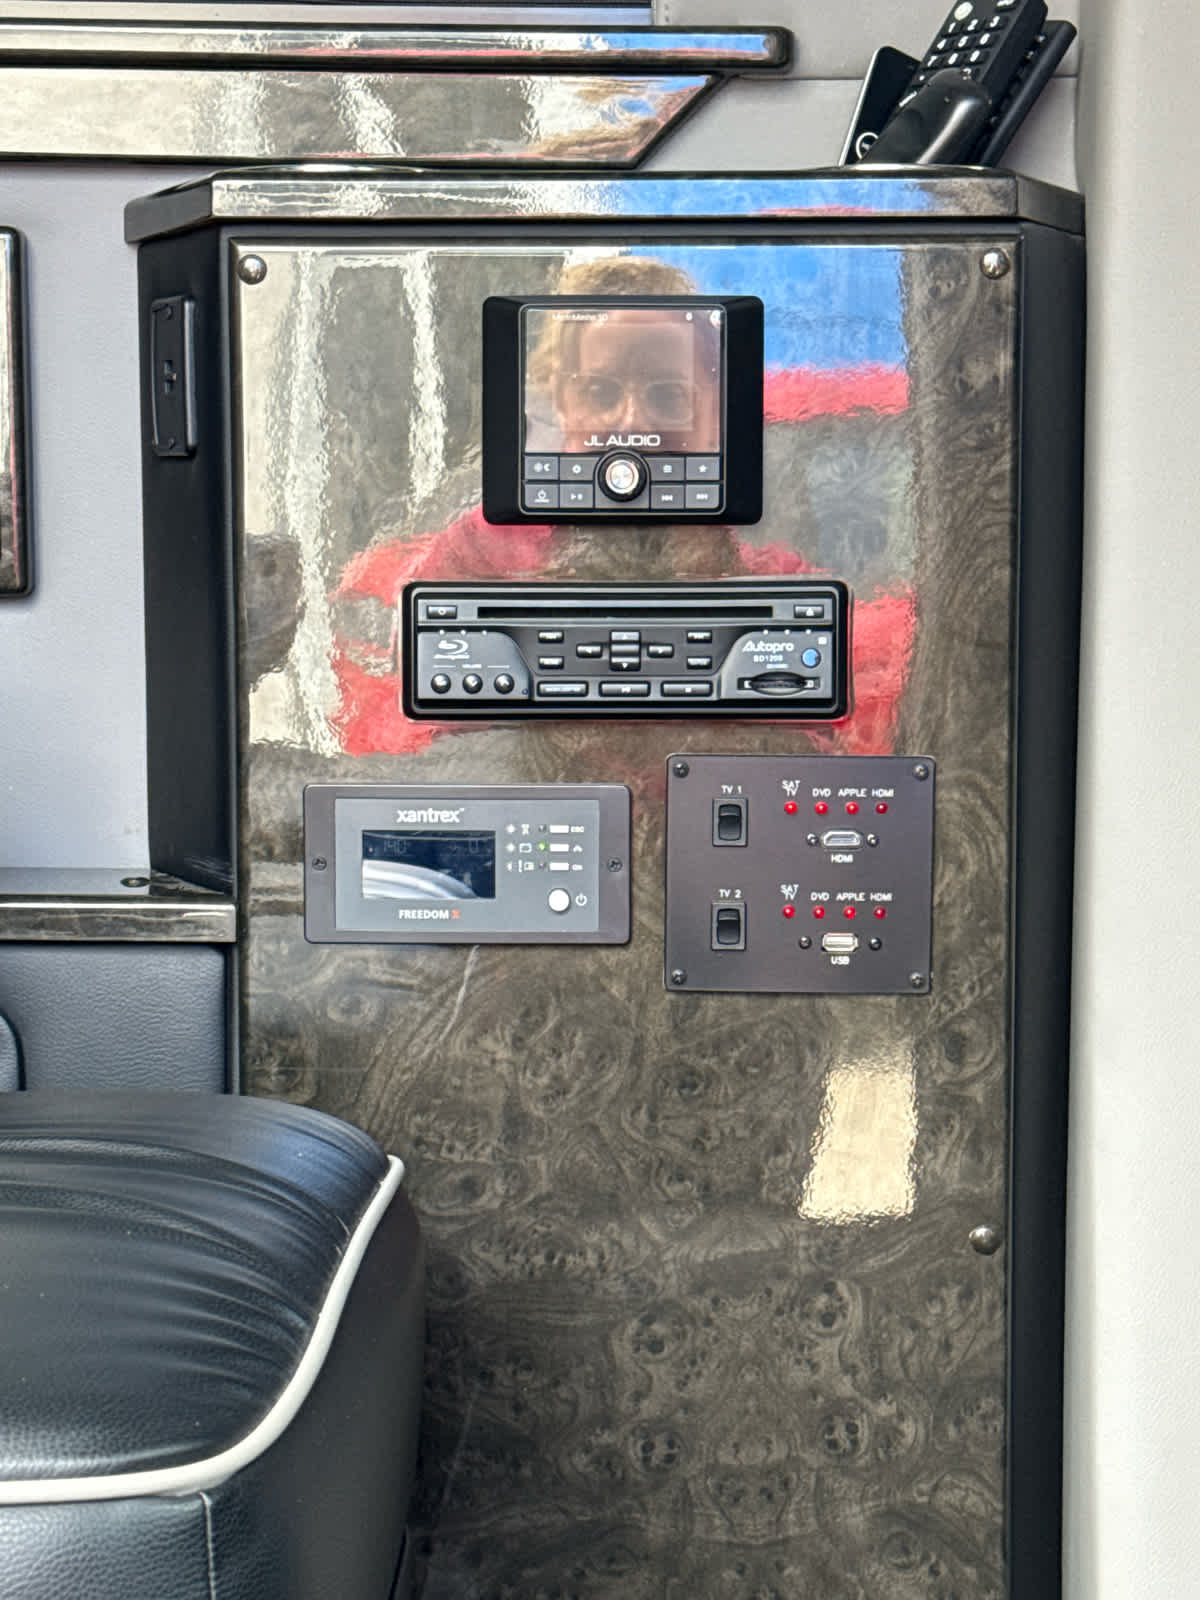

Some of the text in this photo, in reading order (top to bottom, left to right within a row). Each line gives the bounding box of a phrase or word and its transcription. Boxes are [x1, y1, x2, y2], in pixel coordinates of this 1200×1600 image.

[967, 19, 979, 31] 2
[989, 15, 1000, 28] 3
[584, 435, 661, 446] JL AUDIO
[742, 640, 795, 654] Autopro
[782, 780, 800, 789] SAT
[721, 785, 743, 794] TV 1
[785, 788, 798, 797] TV
[812, 788, 895, 797] DVD APPLE HDMI
[396, 808, 460, 823] xantrex
[831, 854, 853, 863] HDMI
[780, 884, 799, 893] SAT
[719, 889, 742, 898] TV 2
[784, 892, 797, 900] TV
[810, 892, 893, 901] DVD APPLE HDMI
[398, 909, 449, 919] FREEDOM
[831, 956, 850, 965] USB
